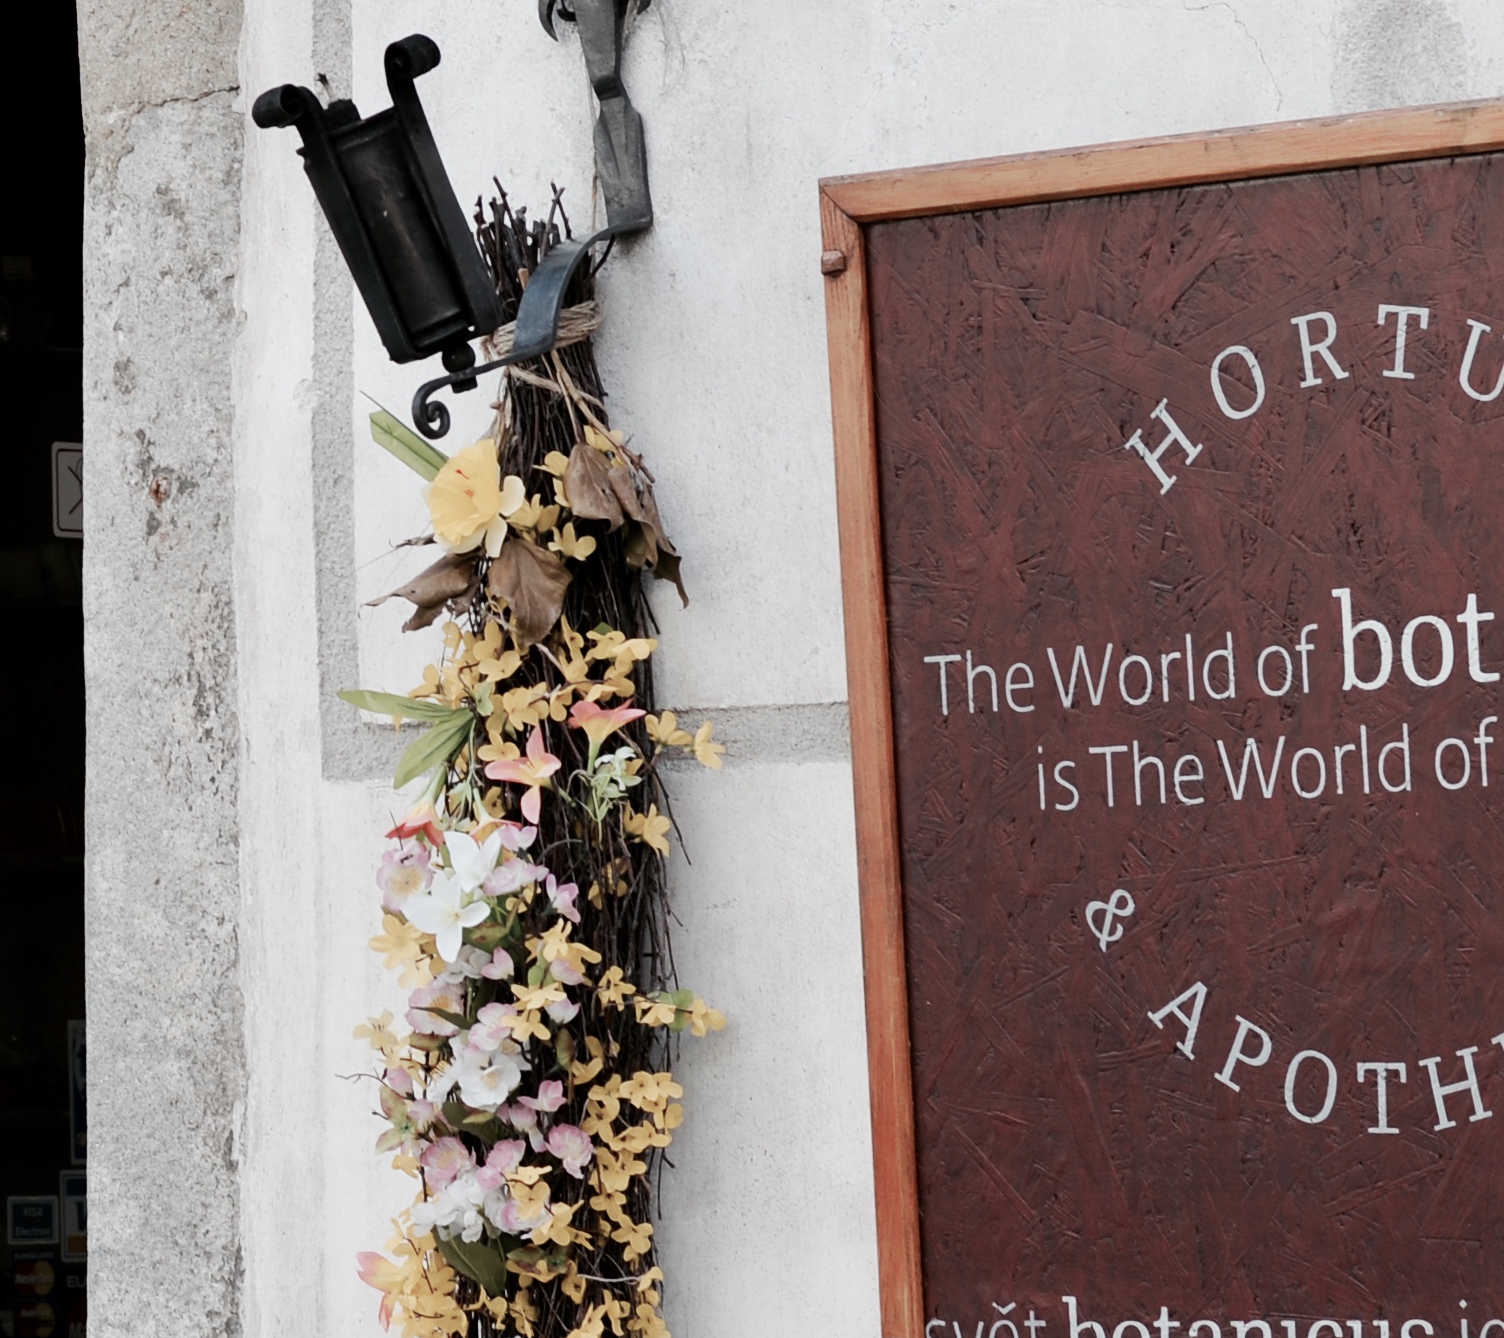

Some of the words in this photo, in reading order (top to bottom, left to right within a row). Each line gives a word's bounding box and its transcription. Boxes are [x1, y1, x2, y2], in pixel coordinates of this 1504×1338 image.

[923, 651, 1035, 716] The
[1047, 632, 1236, 709] World
[1257, 623, 1319, 697] of
[1037, 747, 1080, 811] is
[1089, 742, 1205, 808] The
[1216, 723, 1411, 801] World
[1434, 716, 1498, 790] of
[1085, 887, 1136, 952] &
